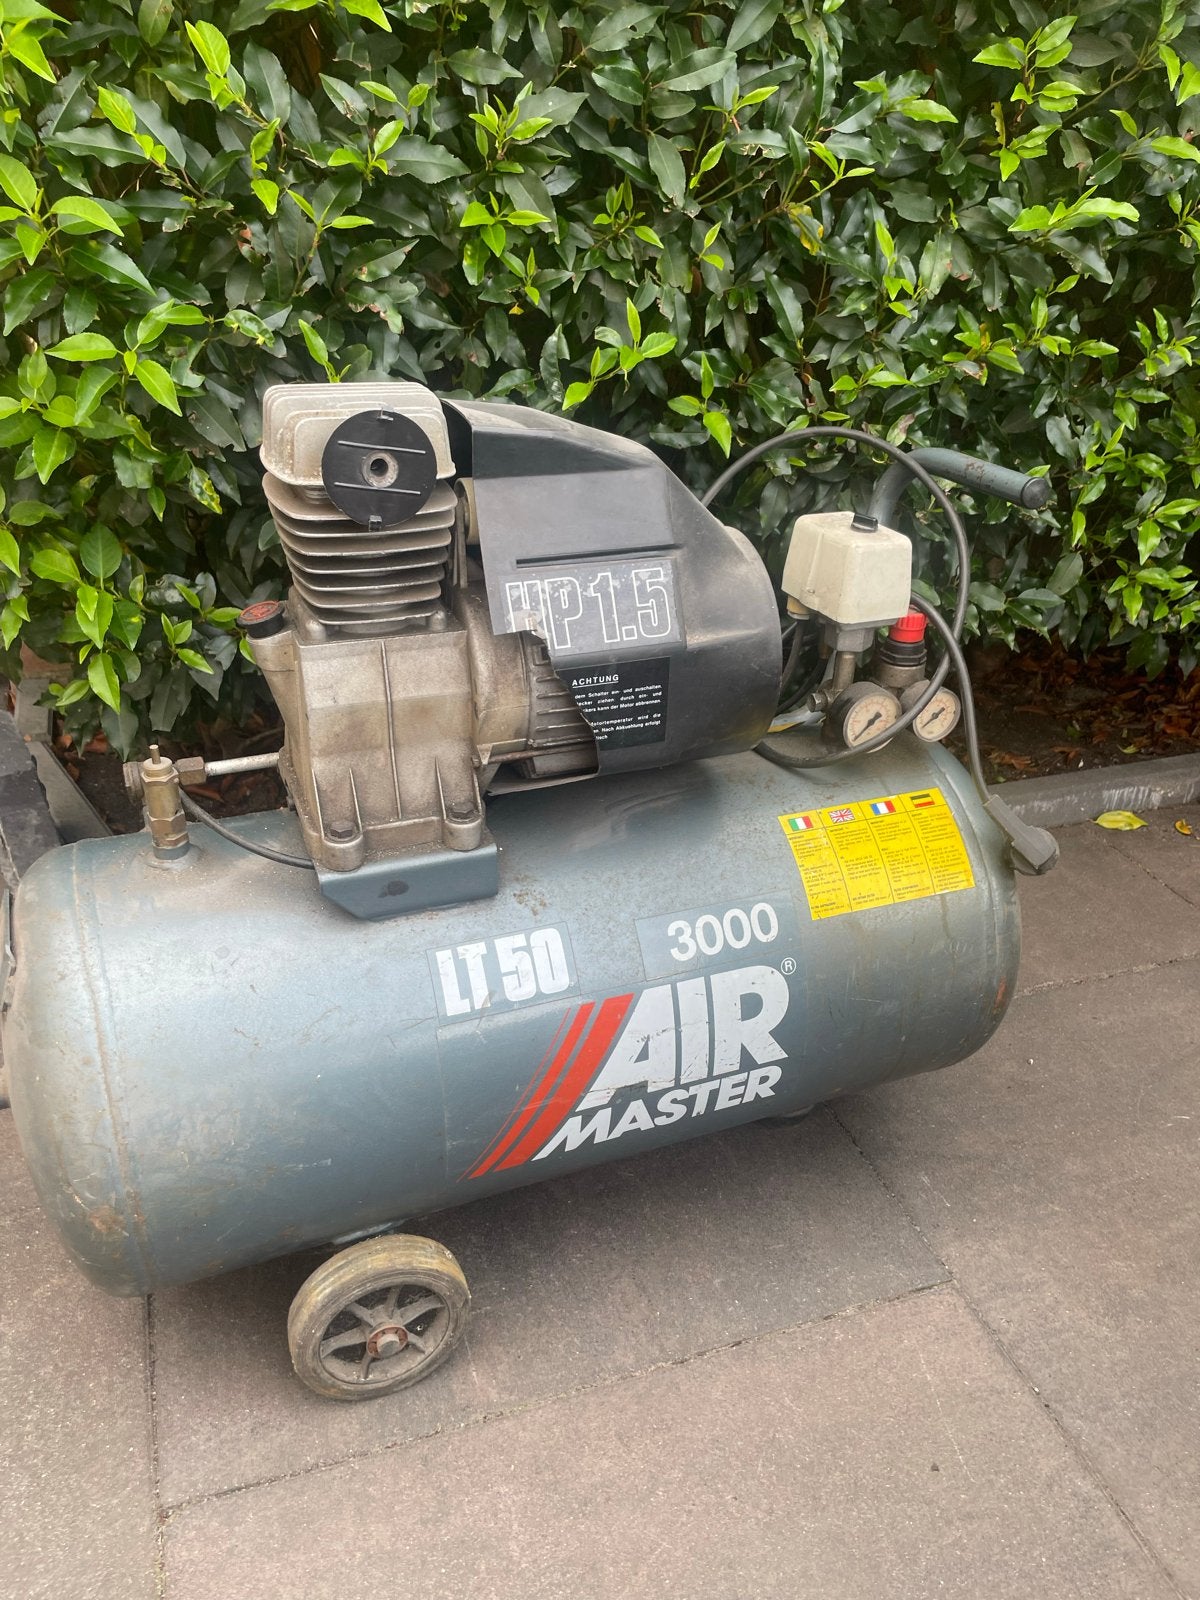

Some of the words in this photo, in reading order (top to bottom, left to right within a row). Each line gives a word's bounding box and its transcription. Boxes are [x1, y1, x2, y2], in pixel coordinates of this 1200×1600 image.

[590, 567, 671, 643] 1.5
[572, 674, 619, 686] ACHTUNG
[435, 942, 491, 1017] LT
[494, 927, 570, 1002] 50
[667, 902, 779, 962] 3000
[574, 964, 790, 1112] AIR
[531, 1065, 783, 1161] MASTER
